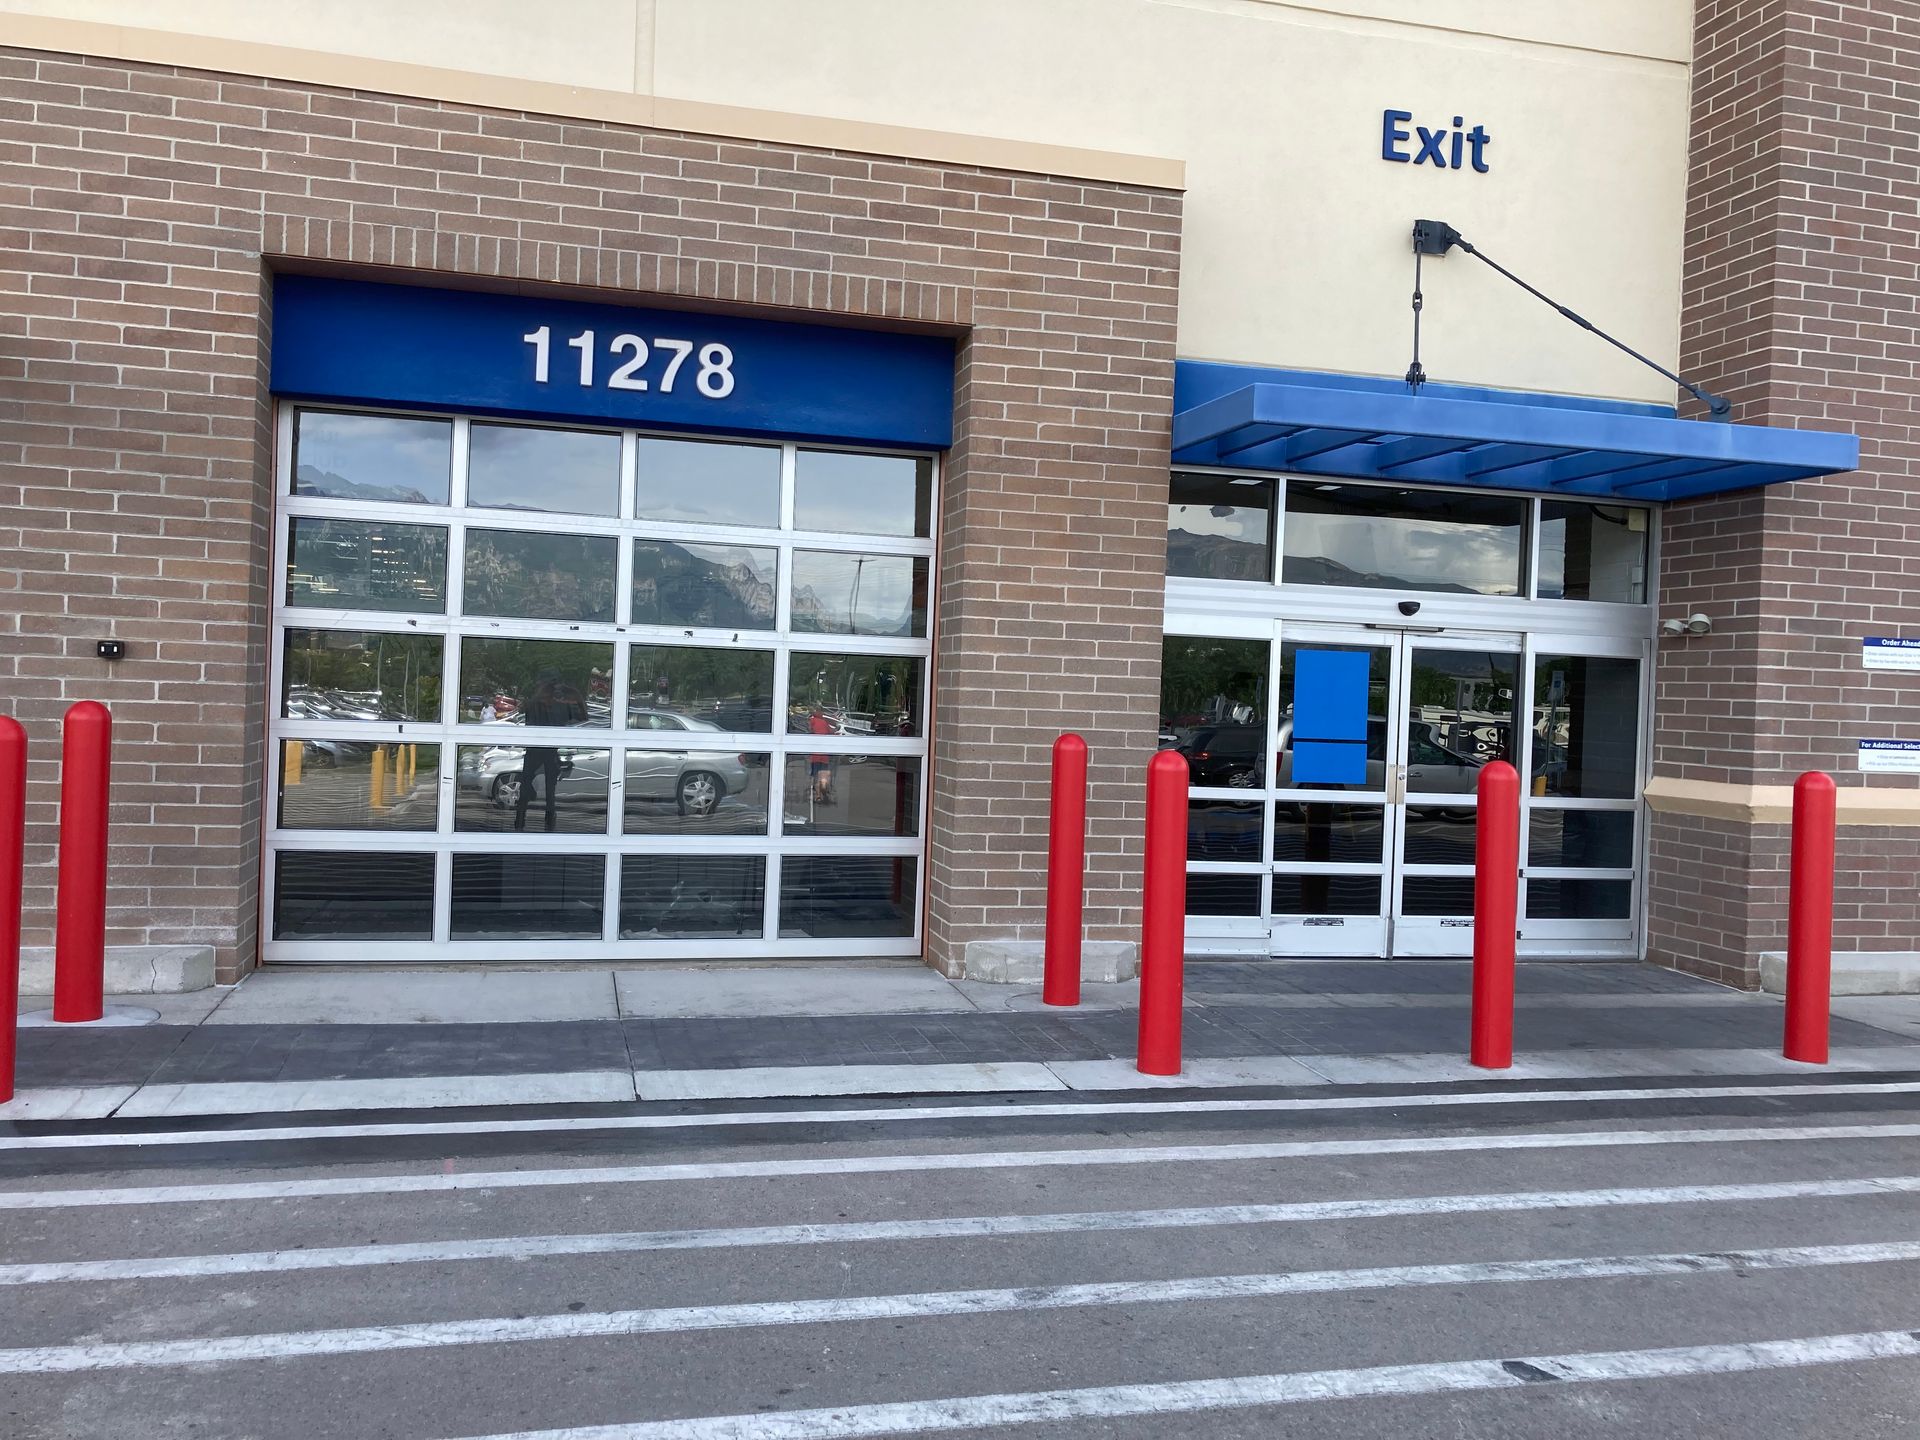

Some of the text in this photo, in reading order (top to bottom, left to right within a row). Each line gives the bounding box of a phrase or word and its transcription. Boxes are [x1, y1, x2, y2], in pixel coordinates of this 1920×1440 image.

[1382, 109, 1490, 173] Exit
[524, 326, 735, 399] 11278
[1881, 639, 1900, 647] Order
